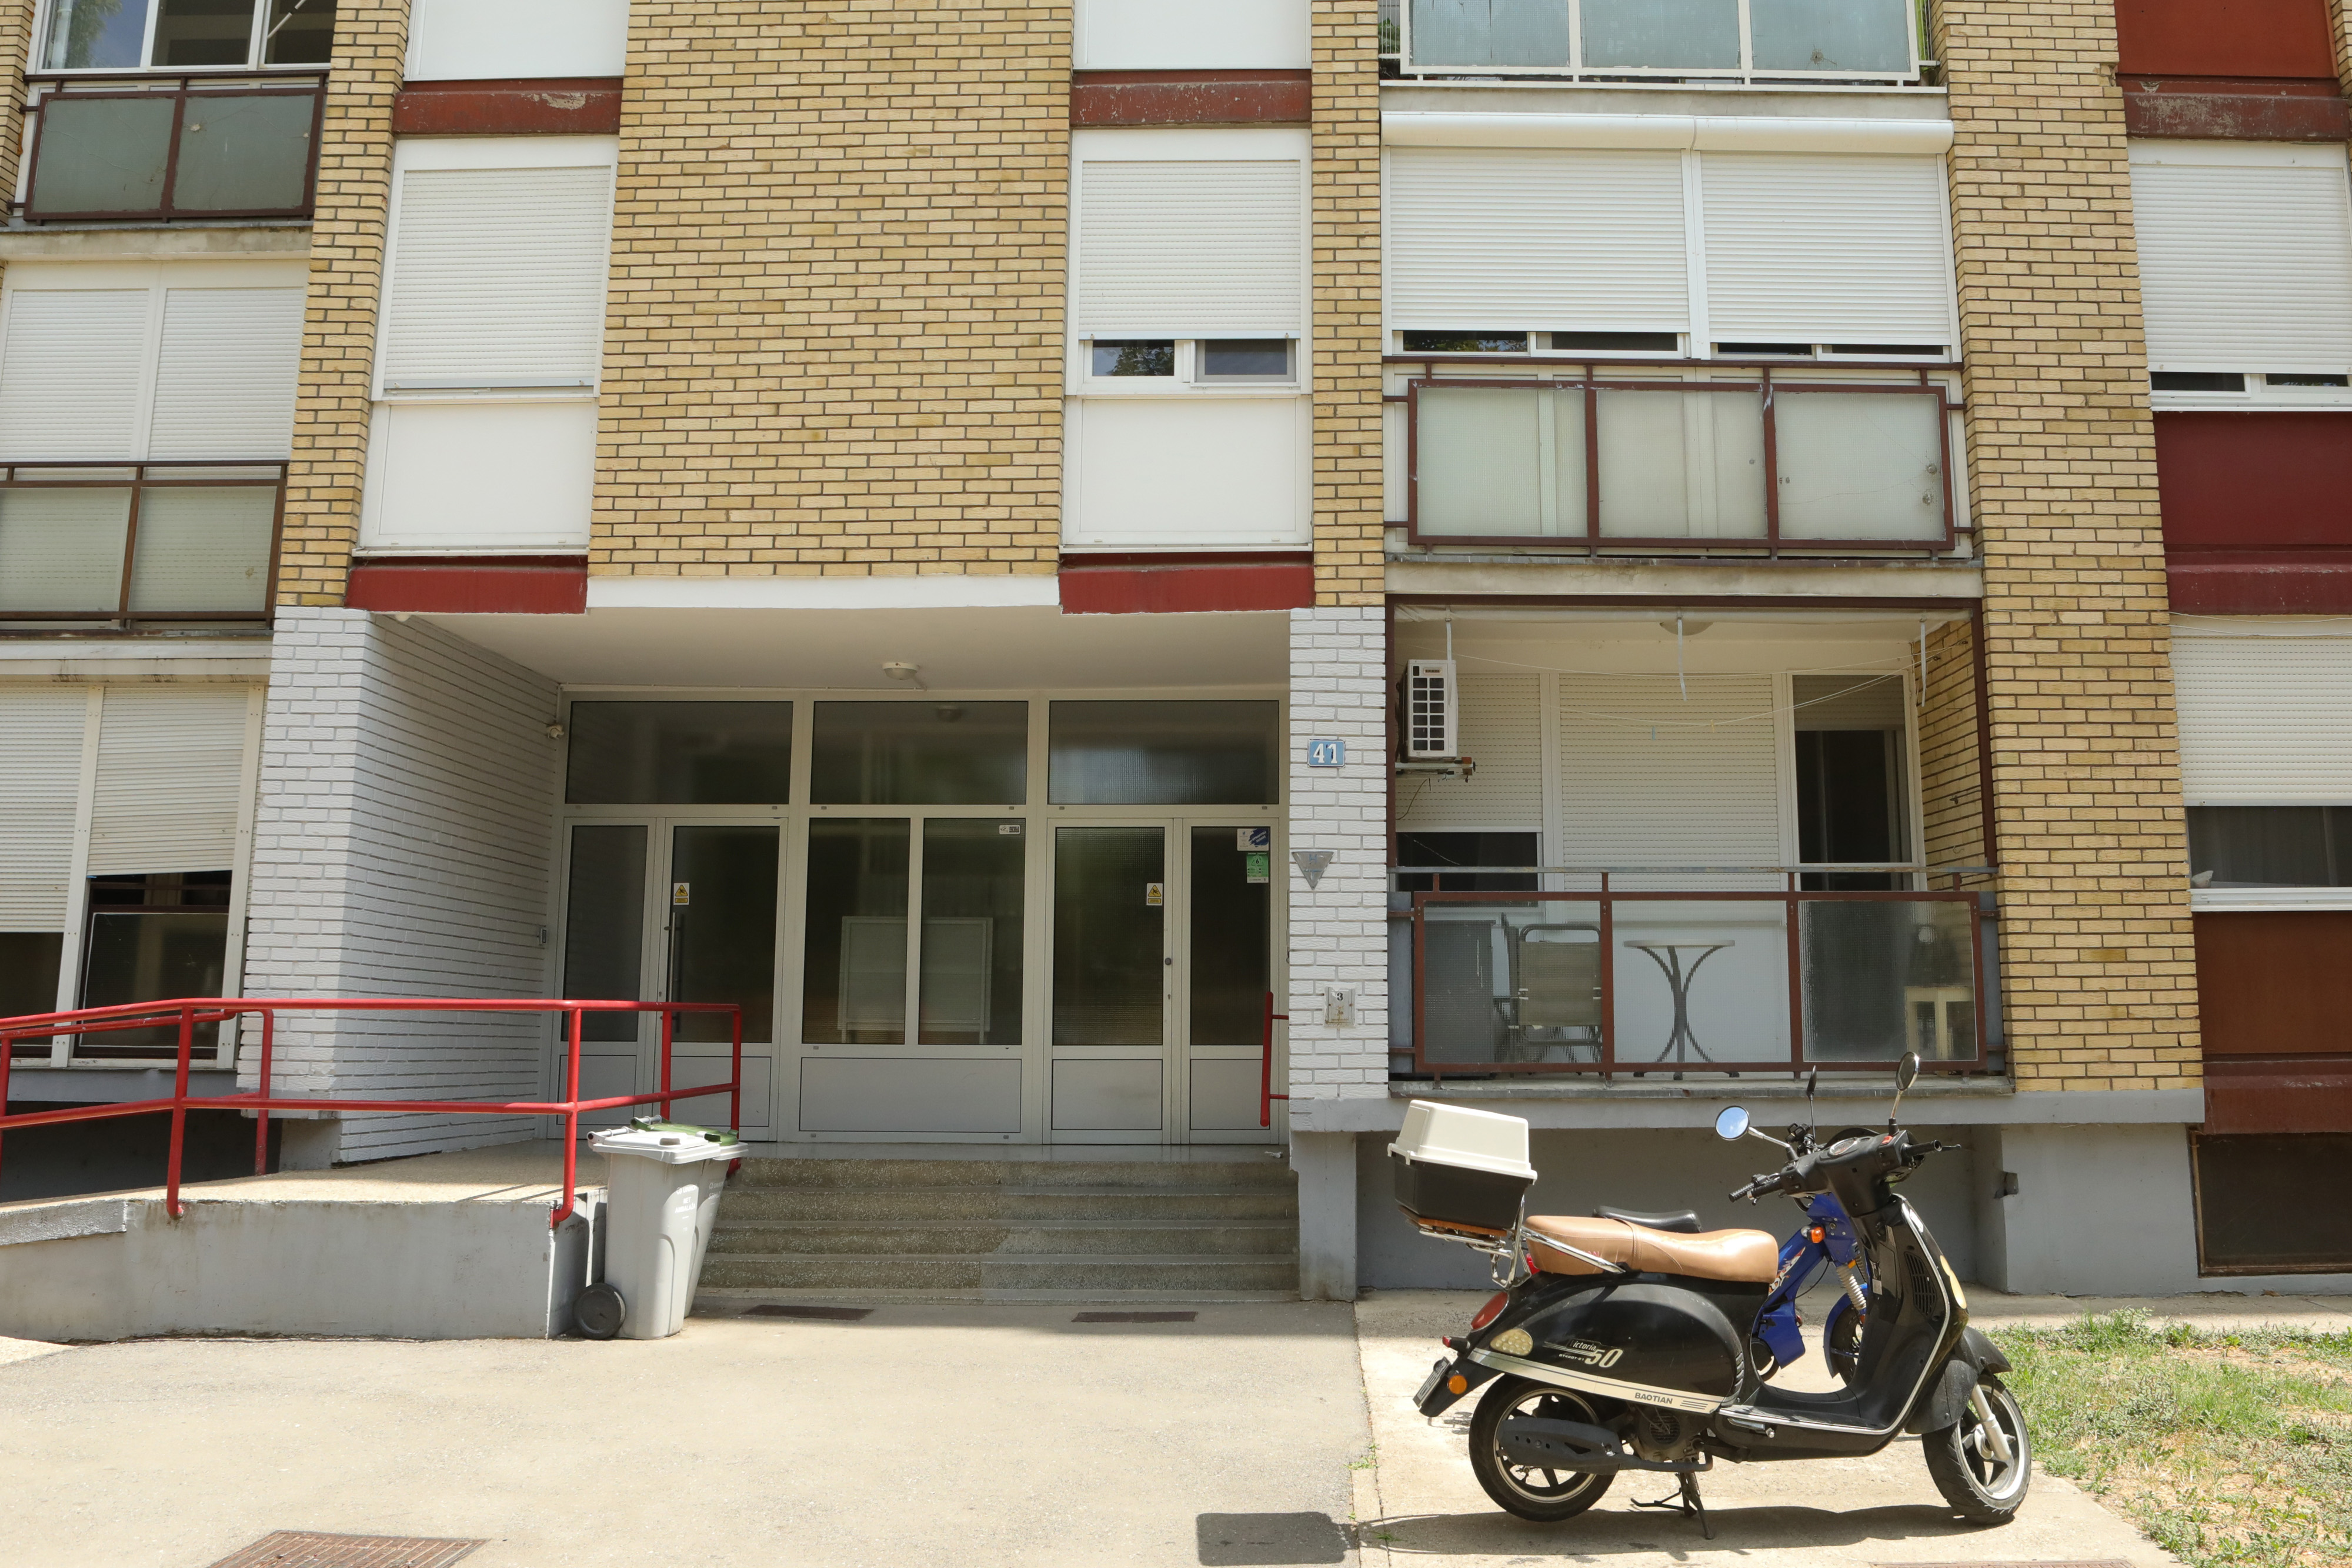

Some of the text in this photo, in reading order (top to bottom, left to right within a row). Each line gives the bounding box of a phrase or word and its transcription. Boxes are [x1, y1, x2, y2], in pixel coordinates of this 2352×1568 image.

[1313, 743, 1337, 763] 41
[1337, 992, 1343, 1000] 3
[1584, 1349, 1623, 1367] 50
[1635, 1392, 1673, 1404] BAOTIAN
